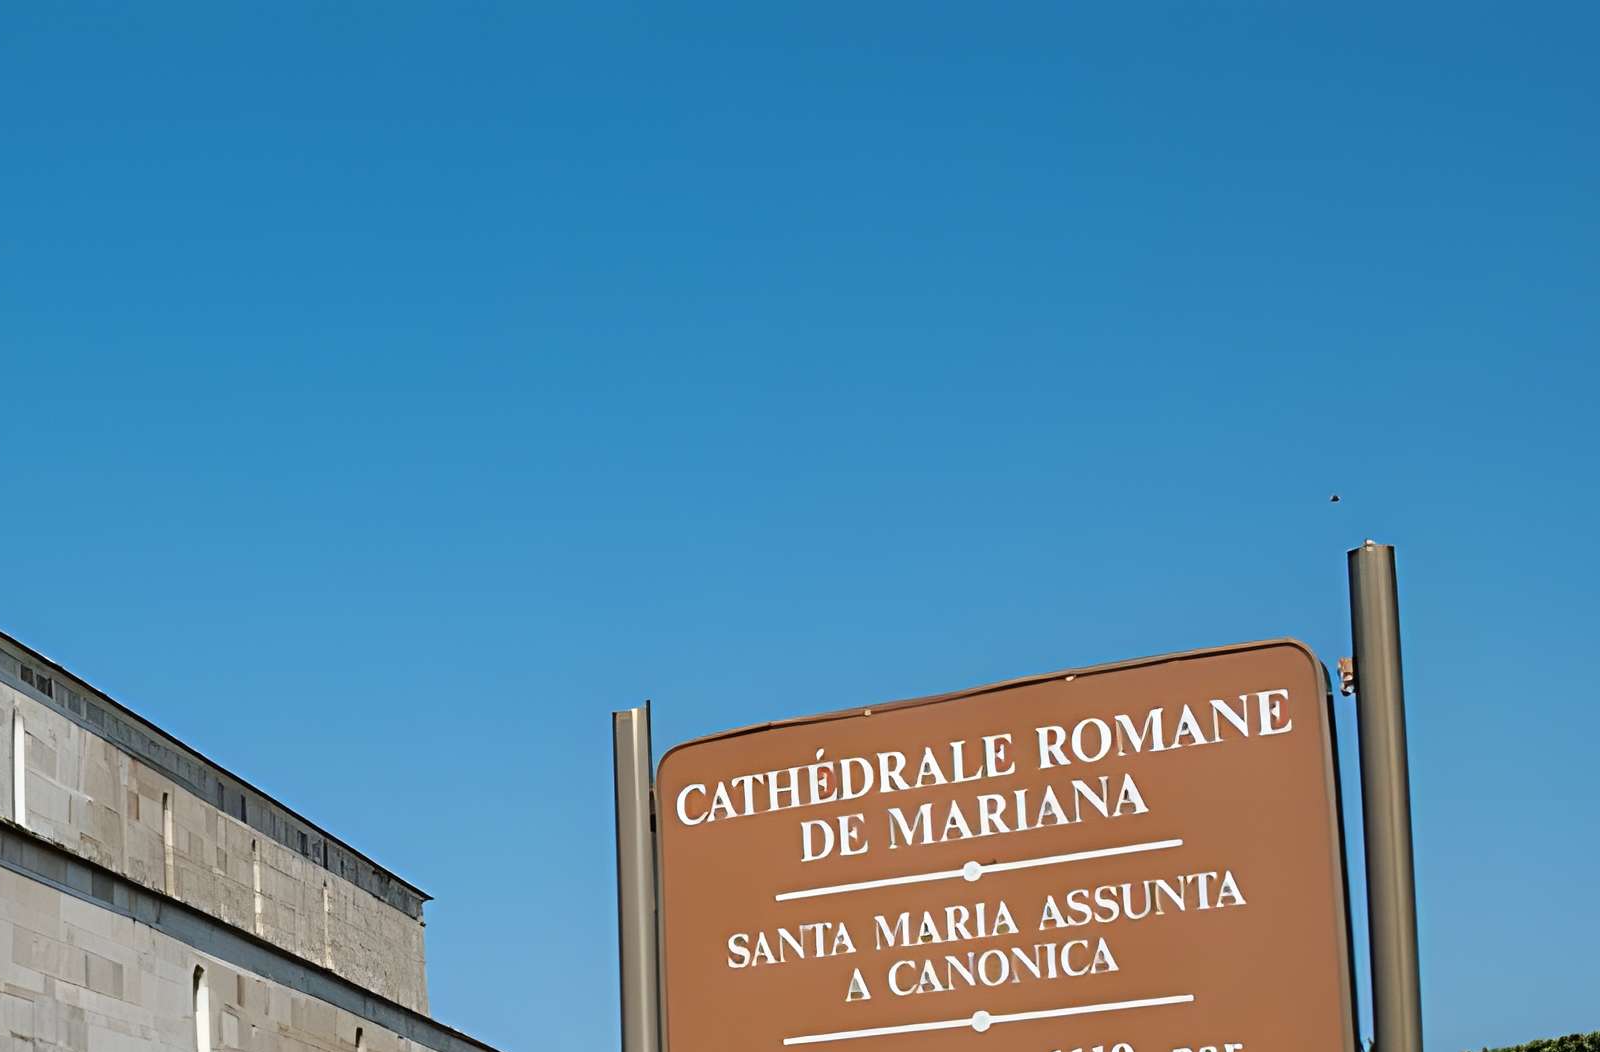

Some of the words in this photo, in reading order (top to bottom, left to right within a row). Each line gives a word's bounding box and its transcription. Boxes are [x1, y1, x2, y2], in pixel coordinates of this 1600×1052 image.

[676, 732, 1016, 826] CATHÉDRALE
[1034, 688, 1293, 771] ROMANE
[799, 812, 869, 863] DE
[886, 773, 1150, 850] MARIANA
[727, 921, 857, 969] SANTA
[873, 900, 1020, 951] MARIA
[1038, 869, 1248, 931] ASSUNTA
[844, 968, 872, 1003] A
[887, 937, 1120, 997] CANONICA
